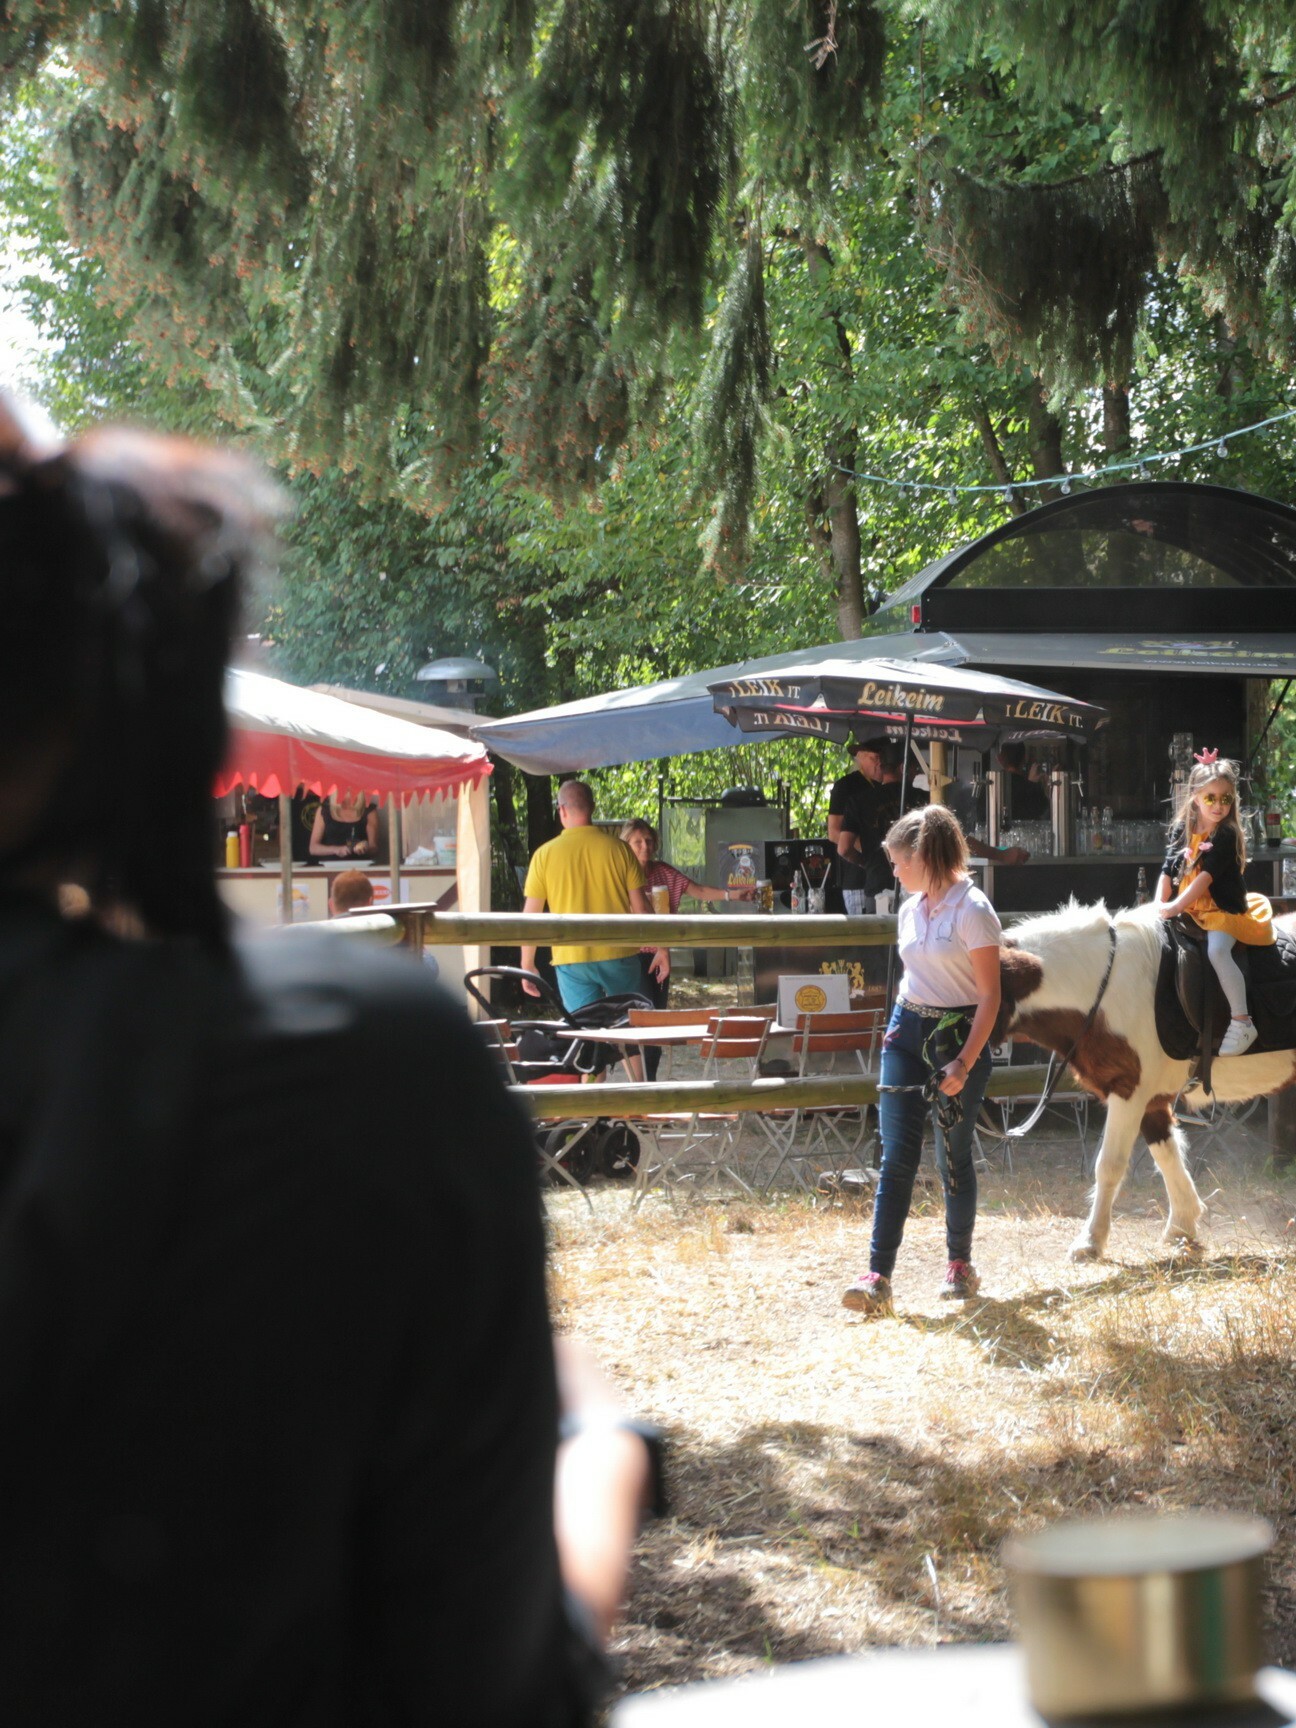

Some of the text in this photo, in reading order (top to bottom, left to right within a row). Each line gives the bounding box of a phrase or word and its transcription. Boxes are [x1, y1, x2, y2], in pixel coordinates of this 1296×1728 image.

[731, 679, 785, 697] LEIK
[787, 685, 801, 699] IT.
[858, 681, 945, 712] Leikeim
[1006, 700, 1084, 728] I LEIK IT.
